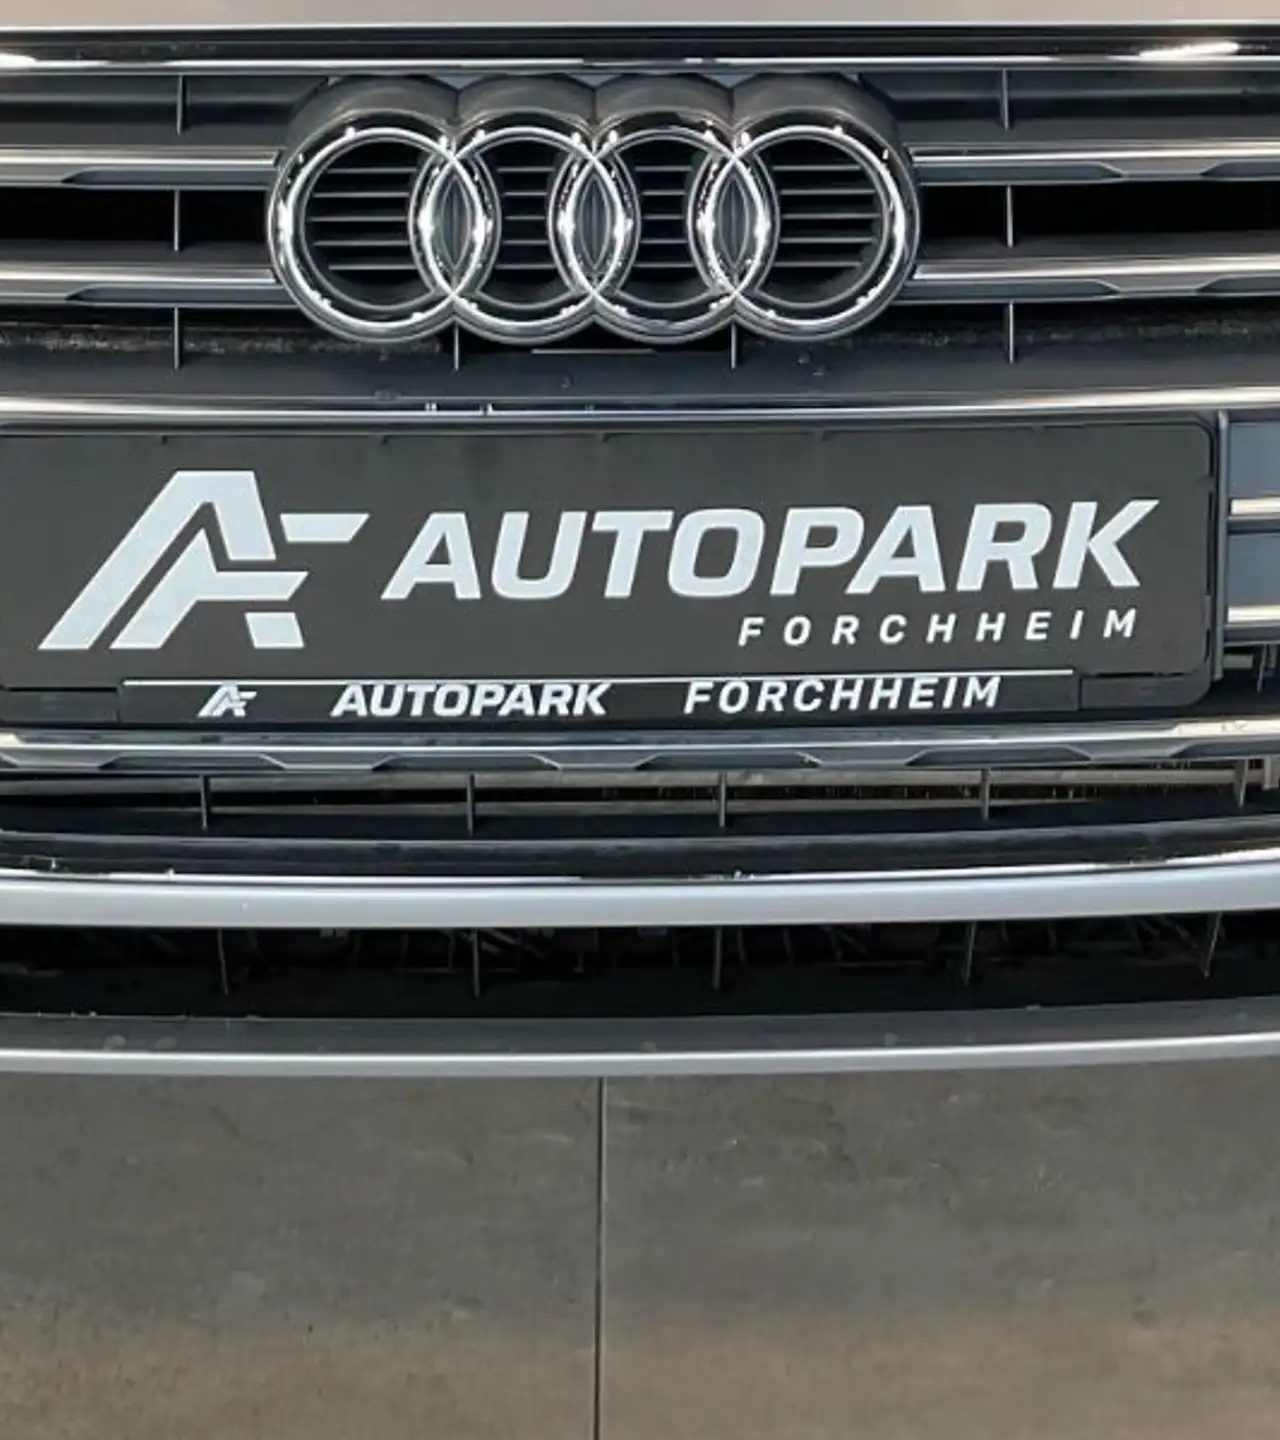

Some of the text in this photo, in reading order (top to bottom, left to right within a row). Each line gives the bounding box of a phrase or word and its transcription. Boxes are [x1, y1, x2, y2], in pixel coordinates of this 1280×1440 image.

[380, 499, 1160, 601] AUTOPARK
[737, 608, 1138, 647] FORCHHEIM
[331, 683, 610, 718] AUTOPARK
[683, 676, 1001, 714] FORCHHEIM
